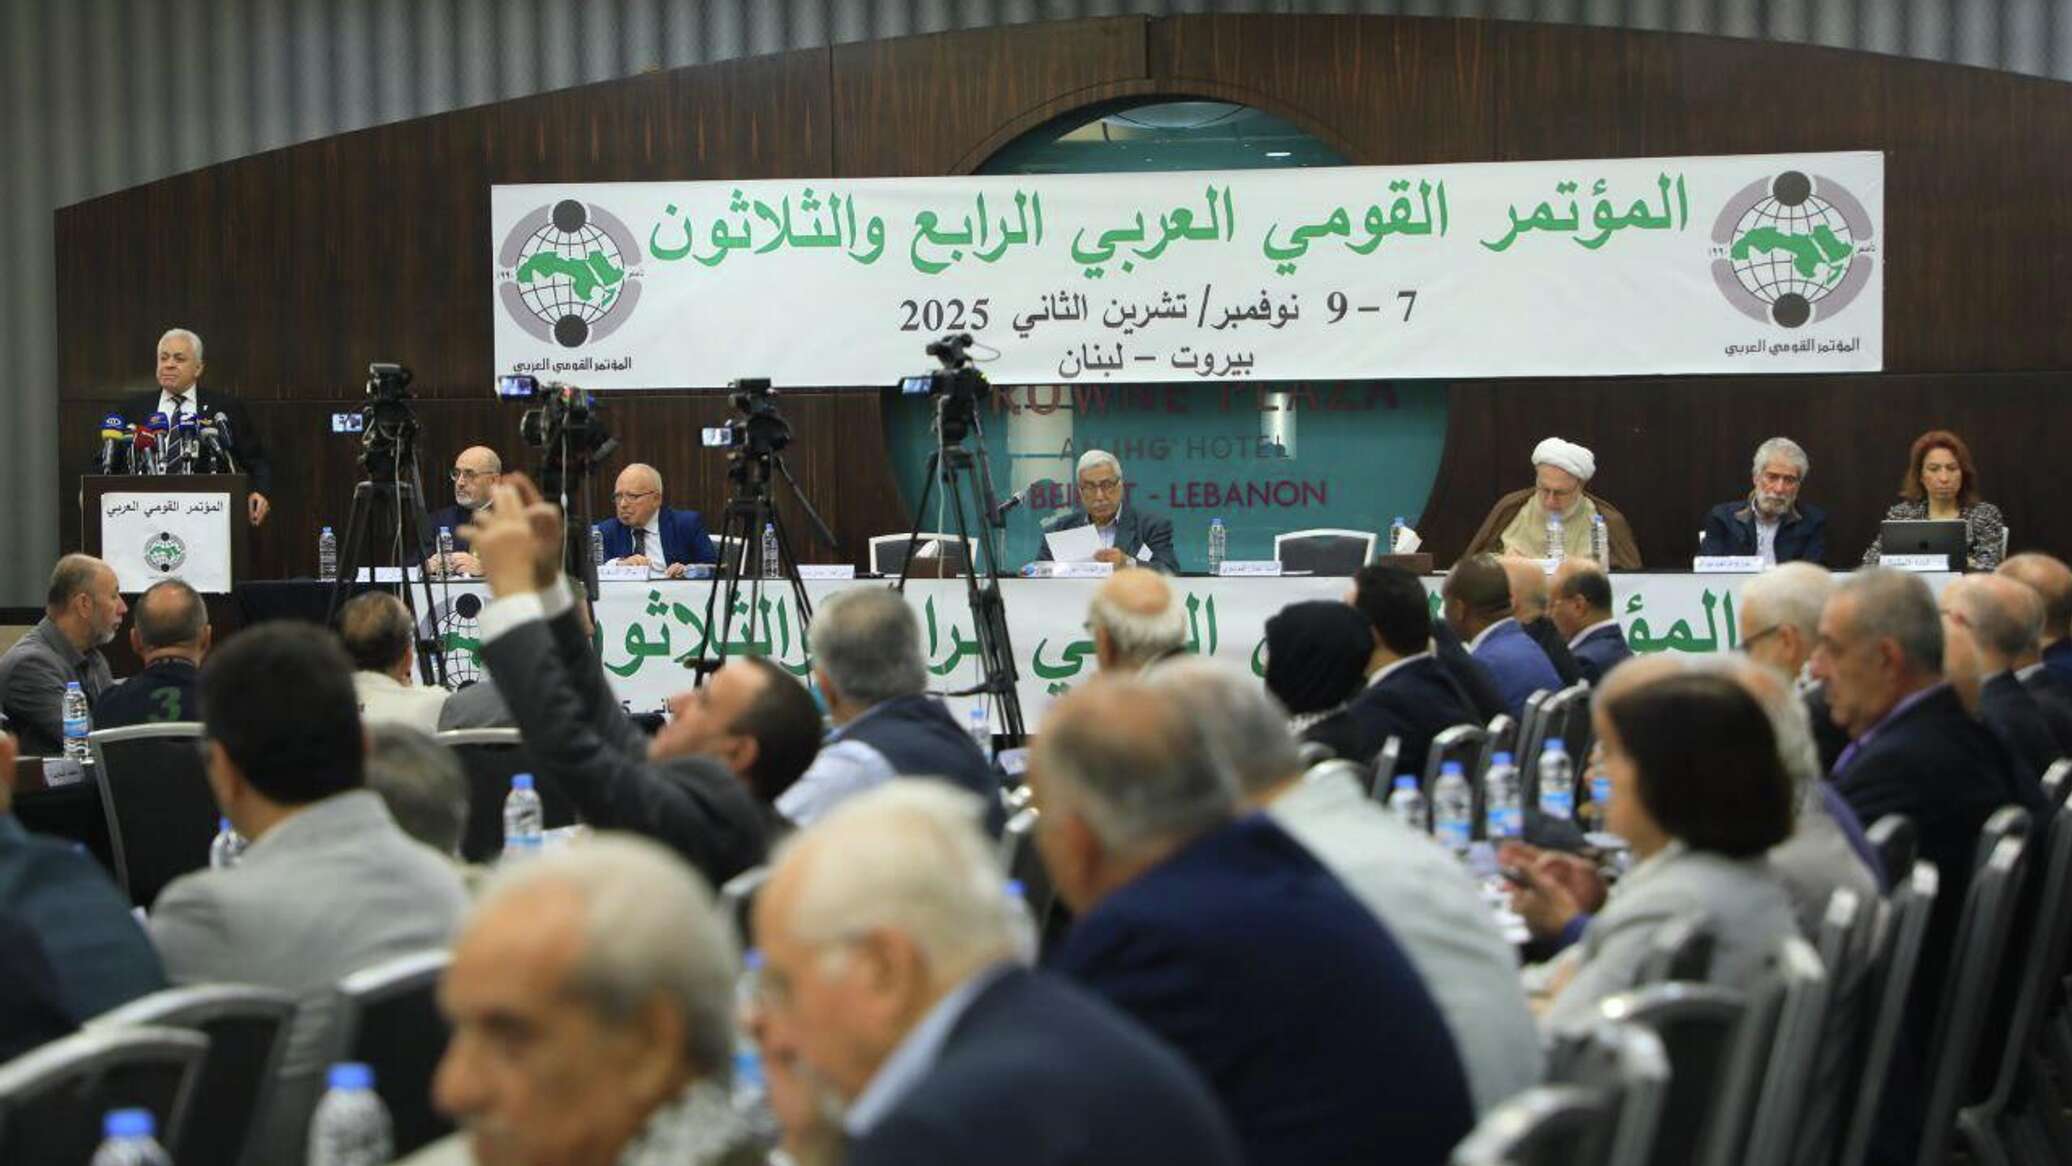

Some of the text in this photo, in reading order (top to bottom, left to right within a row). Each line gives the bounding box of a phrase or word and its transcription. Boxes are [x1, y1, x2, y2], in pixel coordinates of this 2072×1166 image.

[649, 172, 1688, 279] المؤتمر القومي العربي الرابع والثلاثون
[901, 299, 989, 332] 2025
[1012, 290, 1088, 338] الثاني
[1103, 291, 1187, 335] تشرين
[1327, 291, 1348, 324] 9
[1397, 290, 1417, 322] 7
[1059, 343, 1123, 379] لبنان
[1171, 347, 1254, 378] بيروت
[1724, 337, 1860, 357] المؤتمر القومي العربي
[594, 356, 632, 372] المؤتمر
[990, 384, 1191, 416] ROWNE
[1187, 434, 1289, 461] HOTEL
[106, 500, 223, 518] المؤتمر القومي العربي
[1030, 481, 1138, 509] BEIT
[1170, 479, 1327, 508] LEBANON
[149, 686, 182, 722] 3
